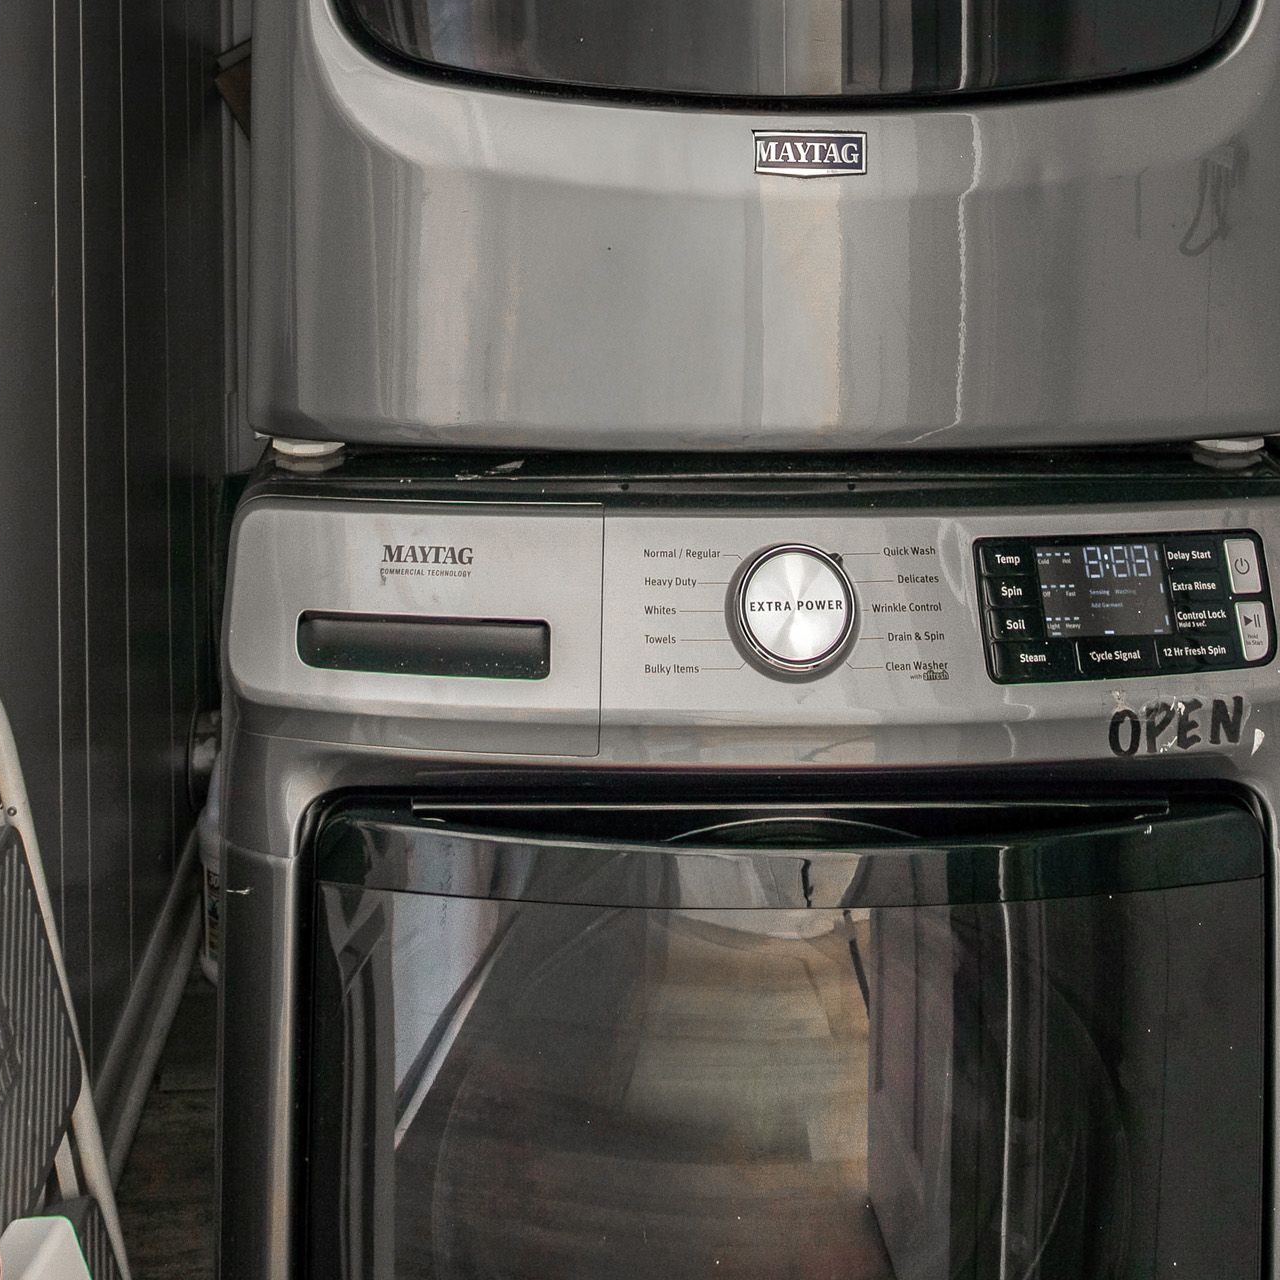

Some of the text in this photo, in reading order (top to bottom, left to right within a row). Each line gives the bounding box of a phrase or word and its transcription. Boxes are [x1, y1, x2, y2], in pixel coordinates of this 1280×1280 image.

[756, 140, 860, 164] MAYTAG
[381, 544, 474, 566] MAYTAG
[643, 549, 676, 558] Normal
[685, 549, 721, 561] Regular
[883, 546, 936, 557] Quick Wash
[1167, 550, 1211, 561] Delay Start
[995, 554, 1020, 566] Temp
[379, 568, 472, 578] COMMERCIAL TECHNOLOGY
[897, 574, 939, 584] Delicates
[644, 577, 697, 588] Heavy Duty
[1172, 581, 1216, 591] Extra Rinse
[1001, 585, 1023, 599] Spin
[644, 605, 677, 615] Whites
[750, 600, 843, 612] EXTRA POWER
[871, 601, 942, 613] Wrinkle Control
[1177, 609, 1226, 620] Control Lock
[1006, 619, 1026, 631] Soil
[644, 634, 677, 644] Towels
[887, 630, 945, 643] Drain & Spin
[1093, 649, 1141, 663] Cycle Signal
[1163, 645, 1226, 657] 12 Hr Fresh Spin
[1019, 653, 1047, 664] Steam
[644, 664, 700, 676] Bulky Items
[885, 661, 948, 672] Clean Washer
[922, 669, 949, 681] affresh
[1109, 695, 1243, 757] OPEN
